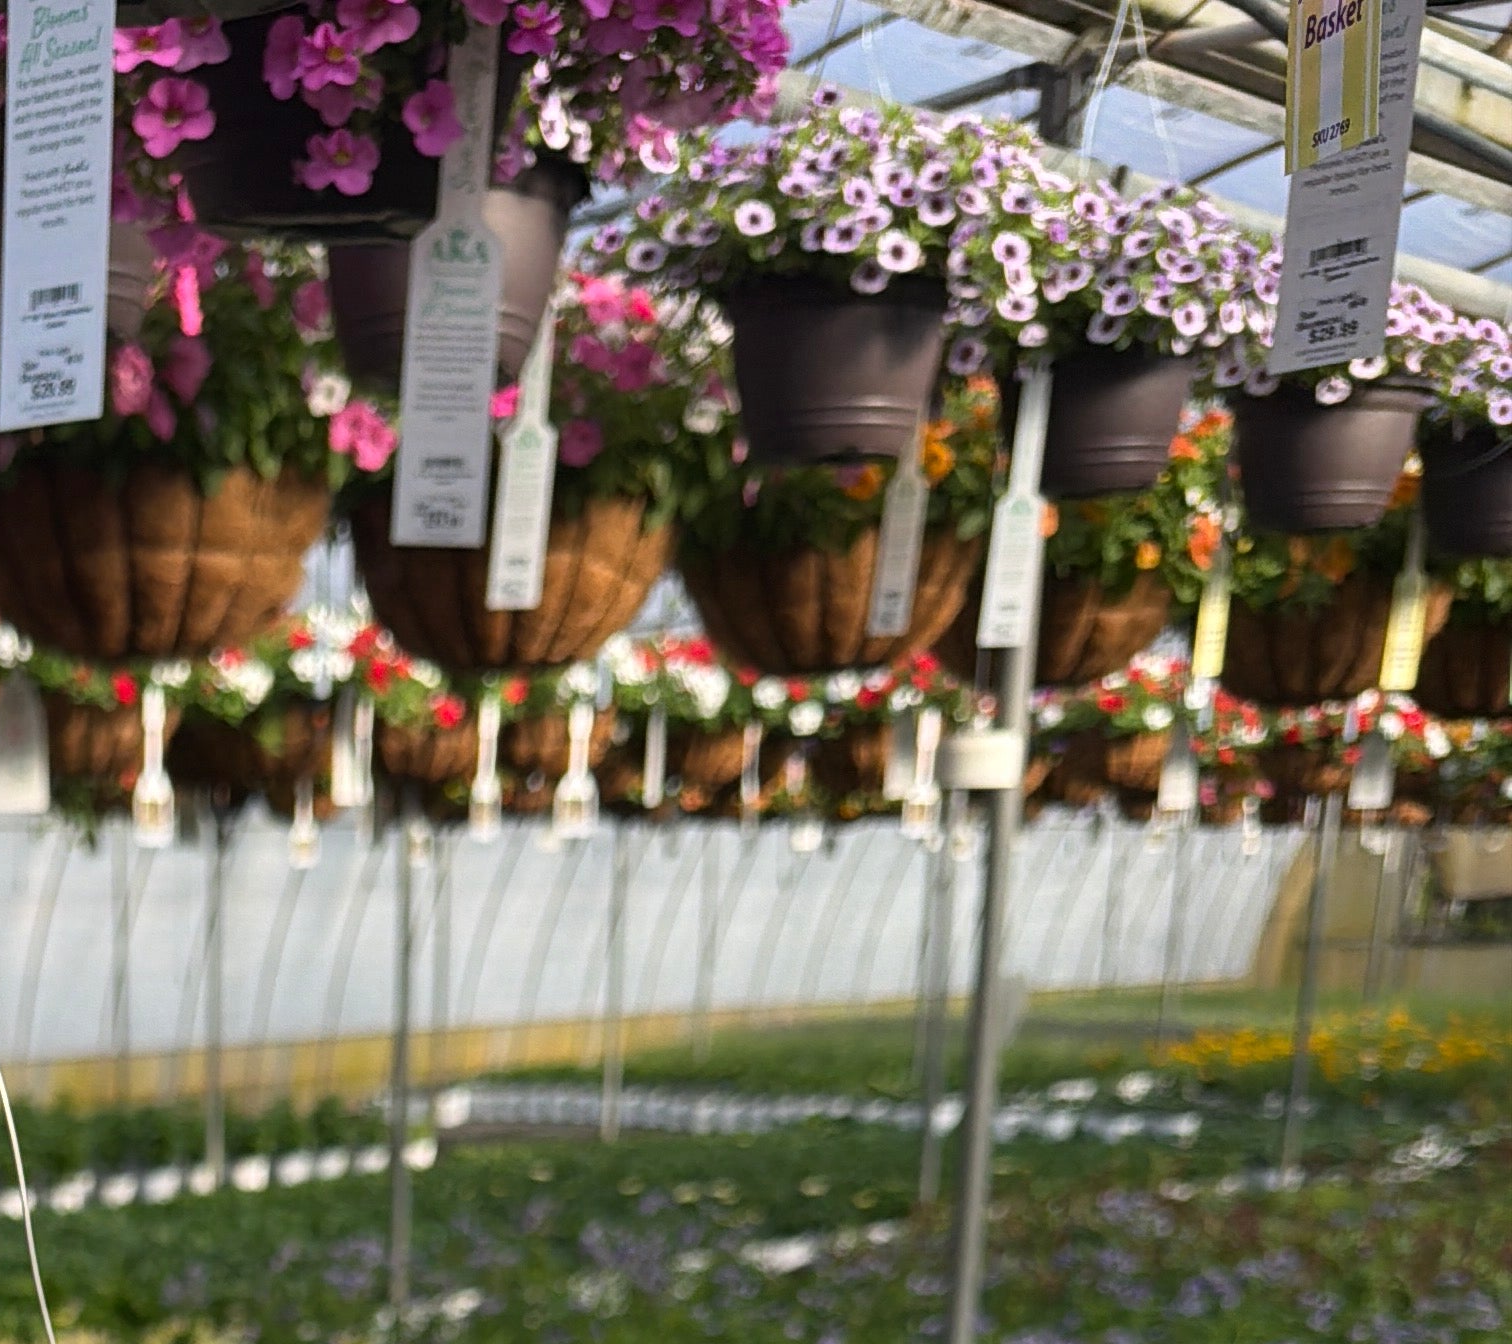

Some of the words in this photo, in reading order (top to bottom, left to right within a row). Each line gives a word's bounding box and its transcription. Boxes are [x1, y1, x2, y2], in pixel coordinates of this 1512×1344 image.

[1304, 0, 1364, 49] Basket
[1312, 125, 1330, 149] SKU
[1330, 118, 1351, 140] 2769
